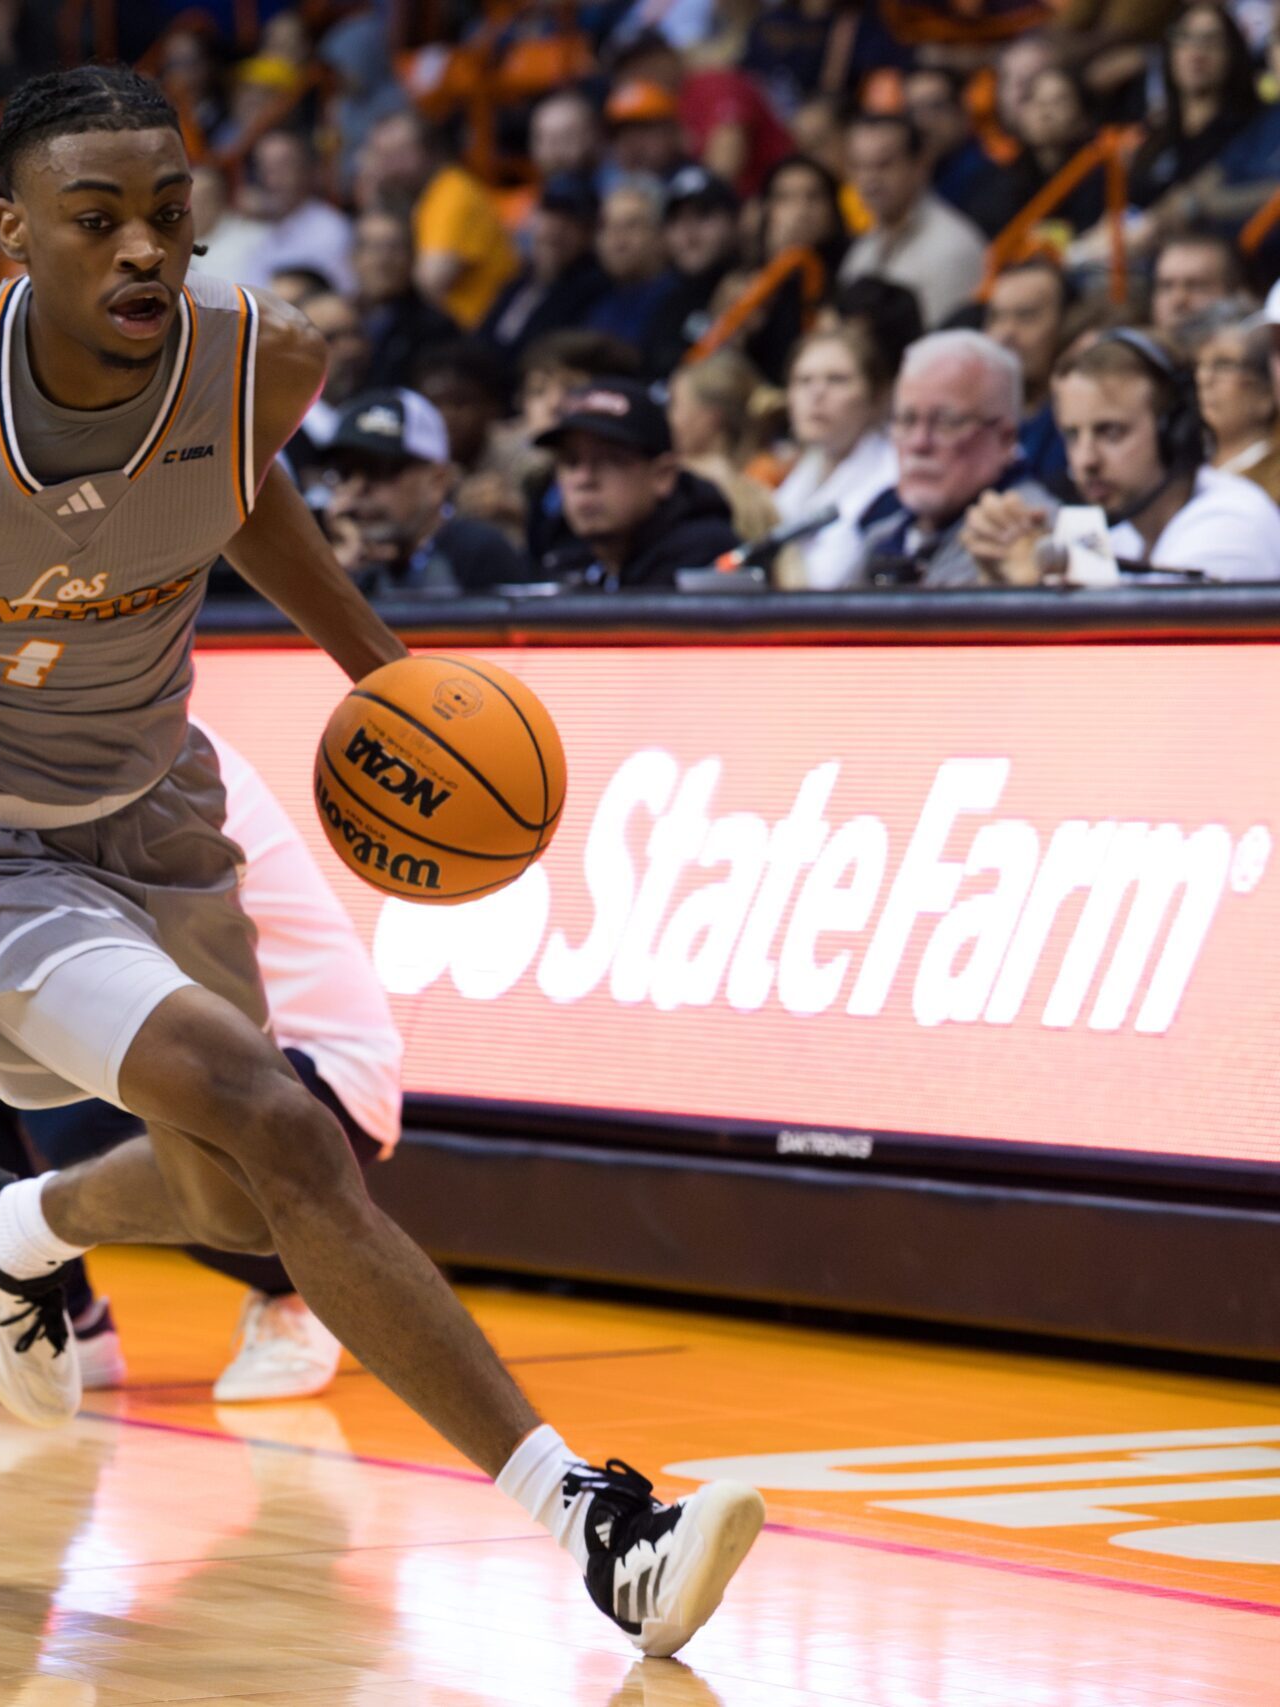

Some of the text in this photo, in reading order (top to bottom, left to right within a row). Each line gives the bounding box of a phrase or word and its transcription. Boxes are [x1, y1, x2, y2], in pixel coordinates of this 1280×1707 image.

[180, 445, 214, 461] USA
[10, 564, 109, 608] Los
[345, 726, 451, 819] NCAA
[316, 774, 441, 889] Wilson
